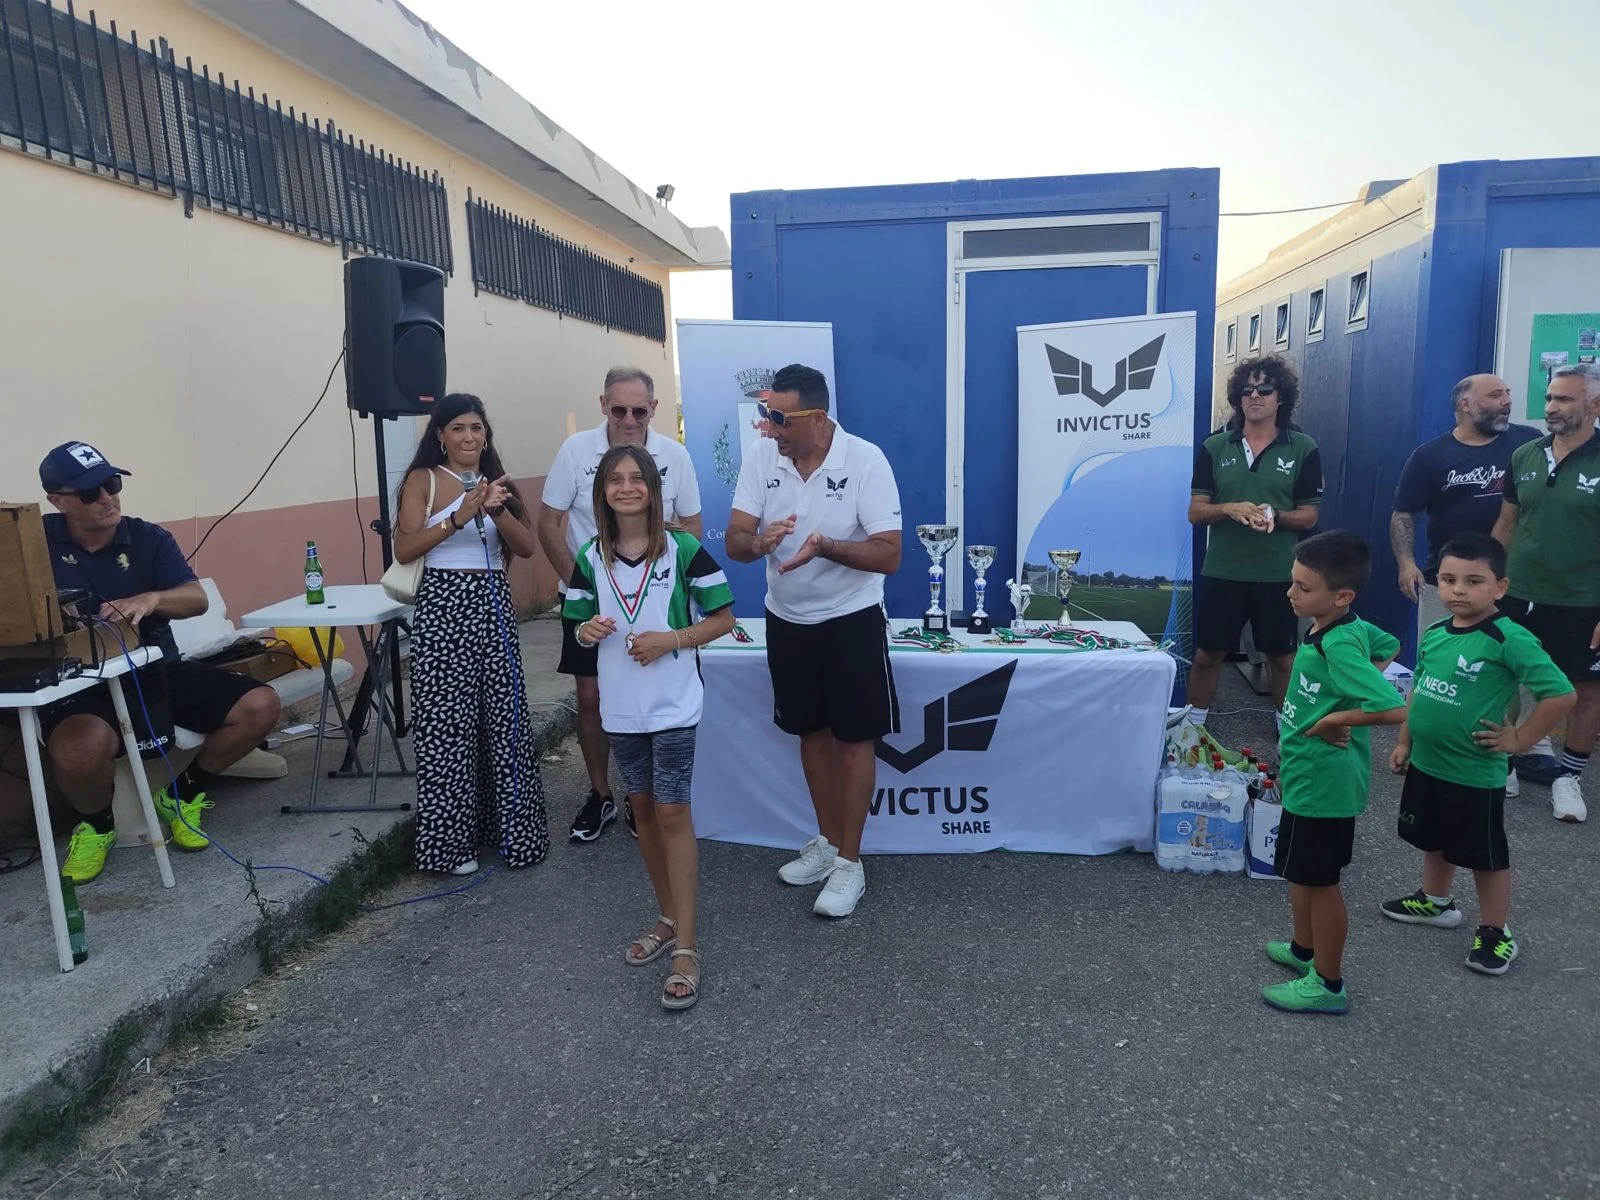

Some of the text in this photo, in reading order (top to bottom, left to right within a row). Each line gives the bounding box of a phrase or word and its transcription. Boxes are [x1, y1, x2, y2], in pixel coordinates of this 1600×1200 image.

[1057, 412, 1151, 433] INVICTUS
[1122, 431, 1151, 441] SHARE
[1422, 675, 1459, 698] NEOS
[136, 735, 169, 751] didas
[868, 786, 989, 816] VICTUS
[941, 820, 991, 835] SHARE
